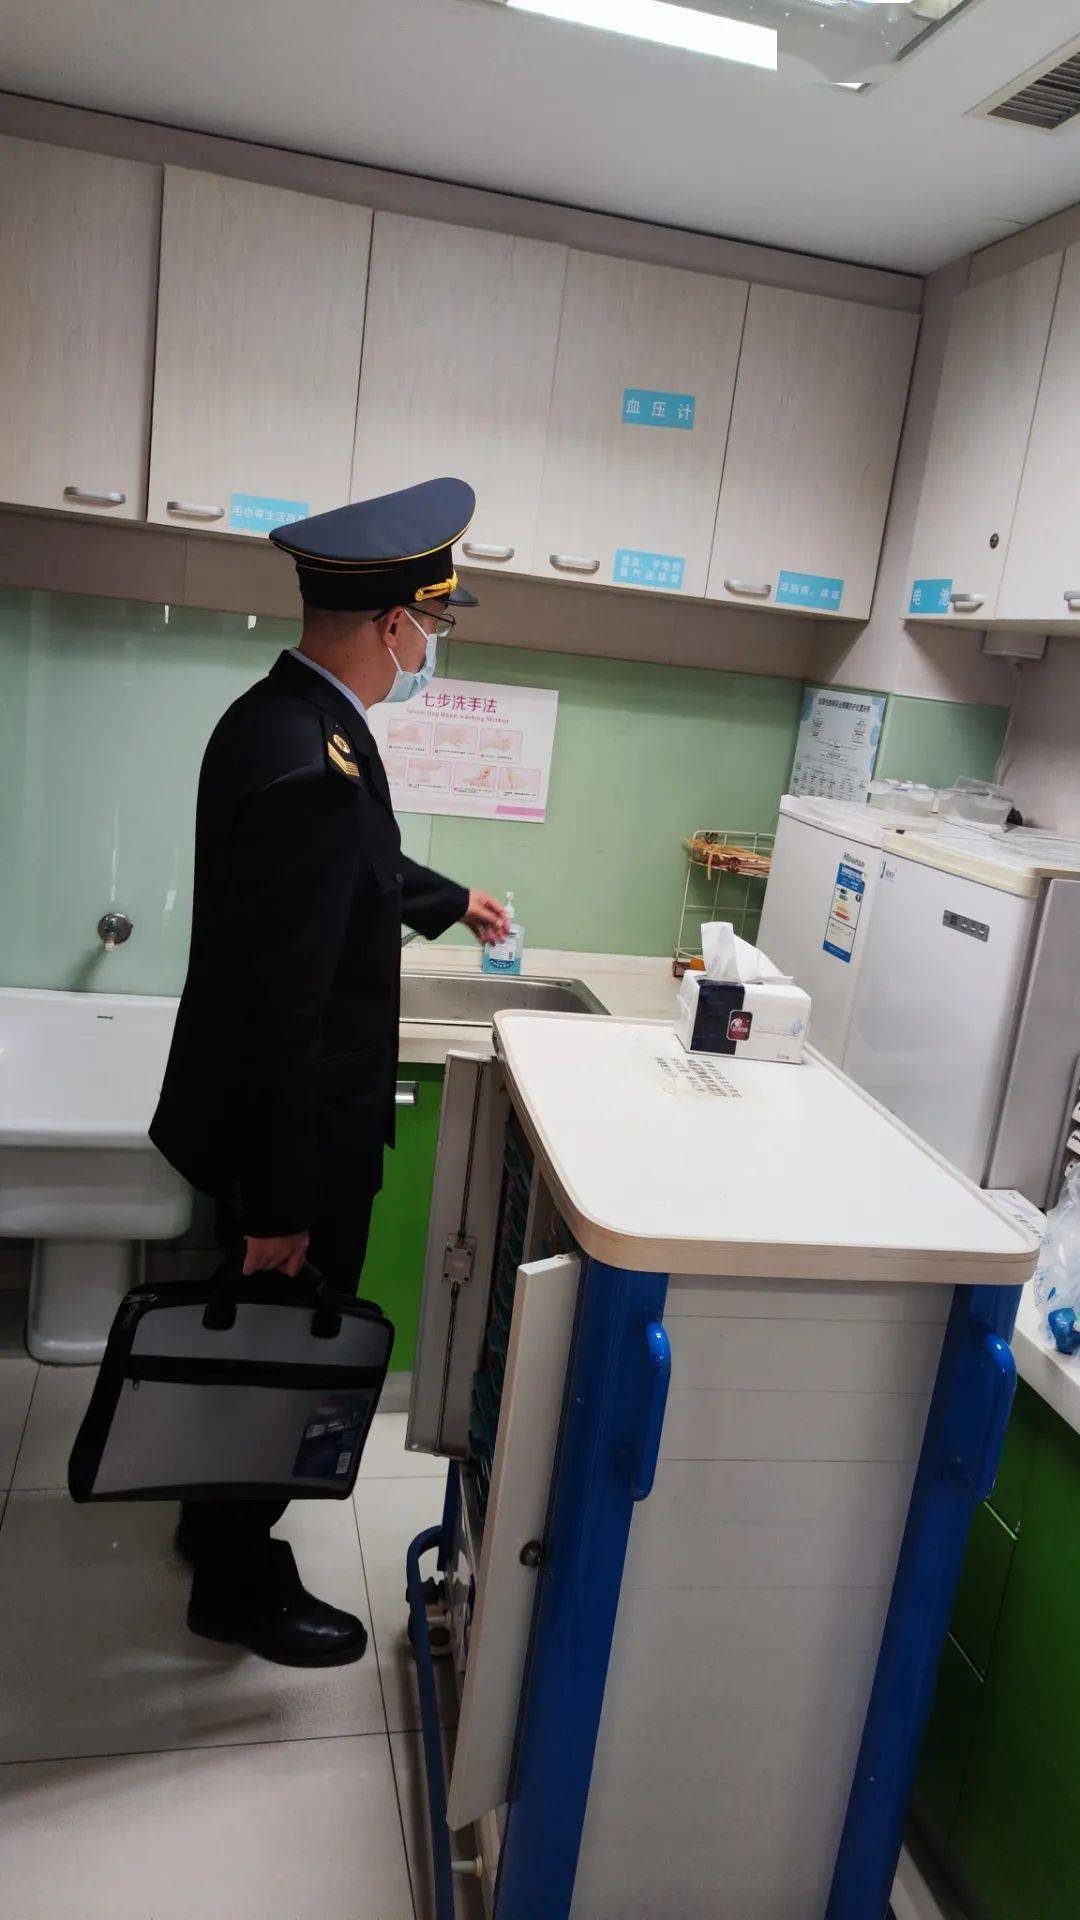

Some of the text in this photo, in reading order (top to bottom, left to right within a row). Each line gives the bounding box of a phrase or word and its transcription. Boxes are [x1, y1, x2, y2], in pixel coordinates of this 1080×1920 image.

[625, 398, 692, 421] 血压计
[422, 692, 498, 714] 七步洗手法
